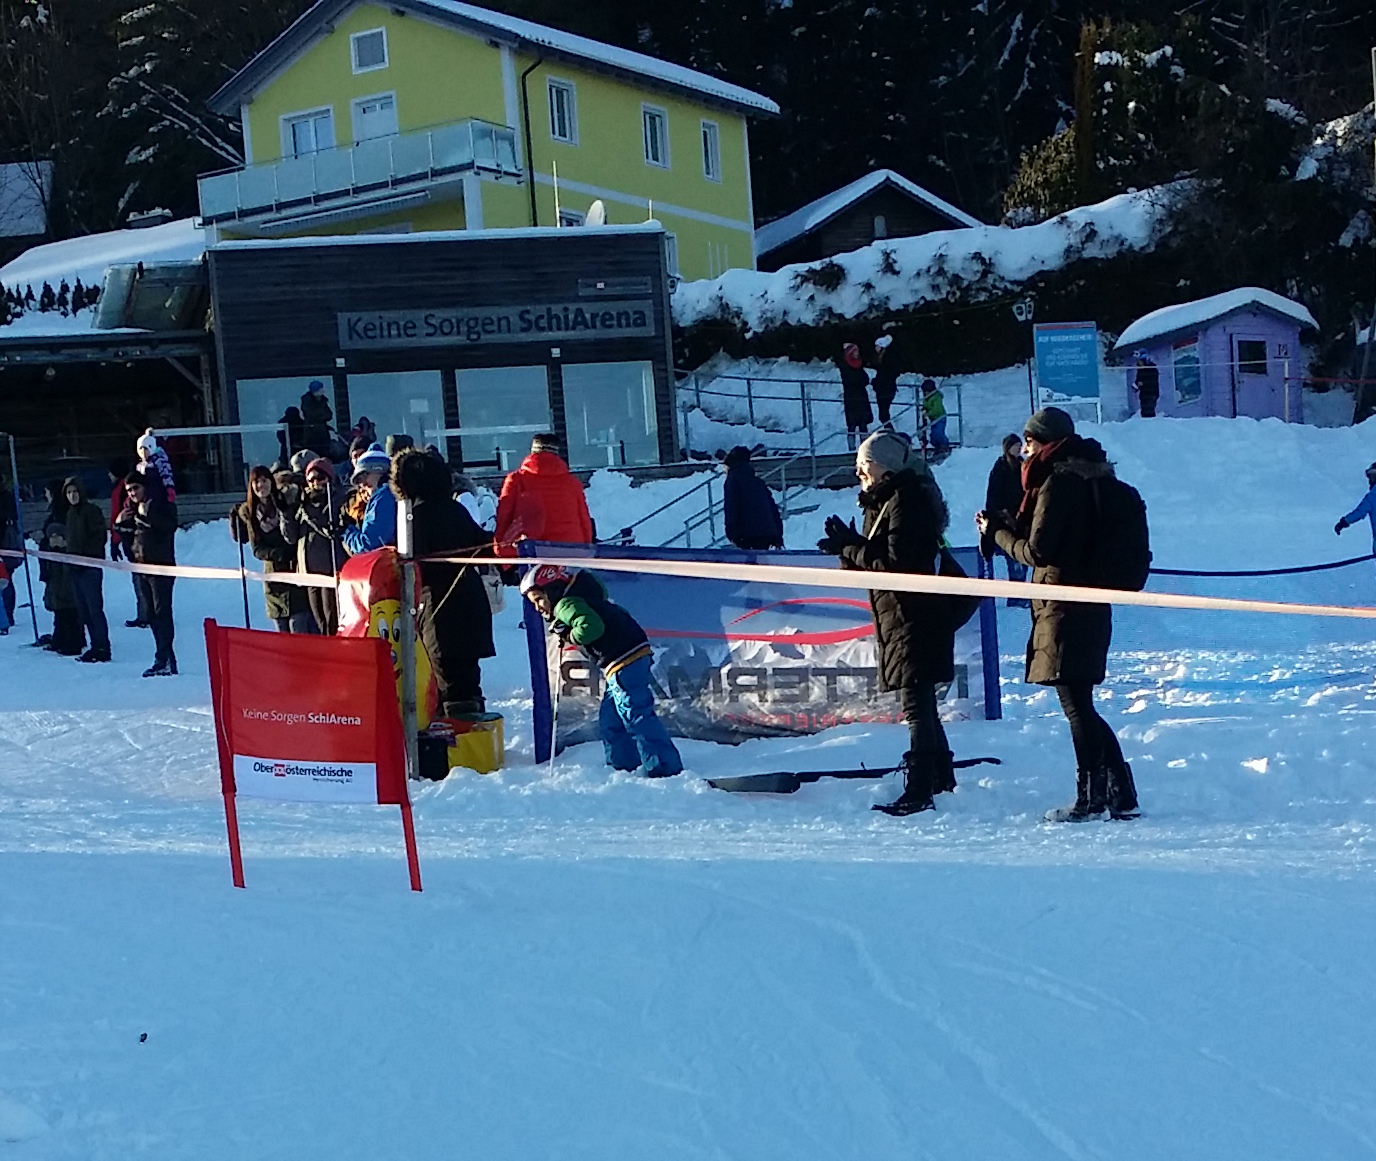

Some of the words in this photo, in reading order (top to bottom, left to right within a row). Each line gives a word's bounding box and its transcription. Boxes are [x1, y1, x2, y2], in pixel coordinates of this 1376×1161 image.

[347, 316, 417, 340] Keine
[424, 313, 512, 342] Sorgen
[519, 307, 647, 333] SchiArena
[242, 708, 269, 721] Keine
[271, 710, 306, 726] Sorgen
[308, 712, 361, 726] SchiArena
[253, 761, 274, 773] Ober
